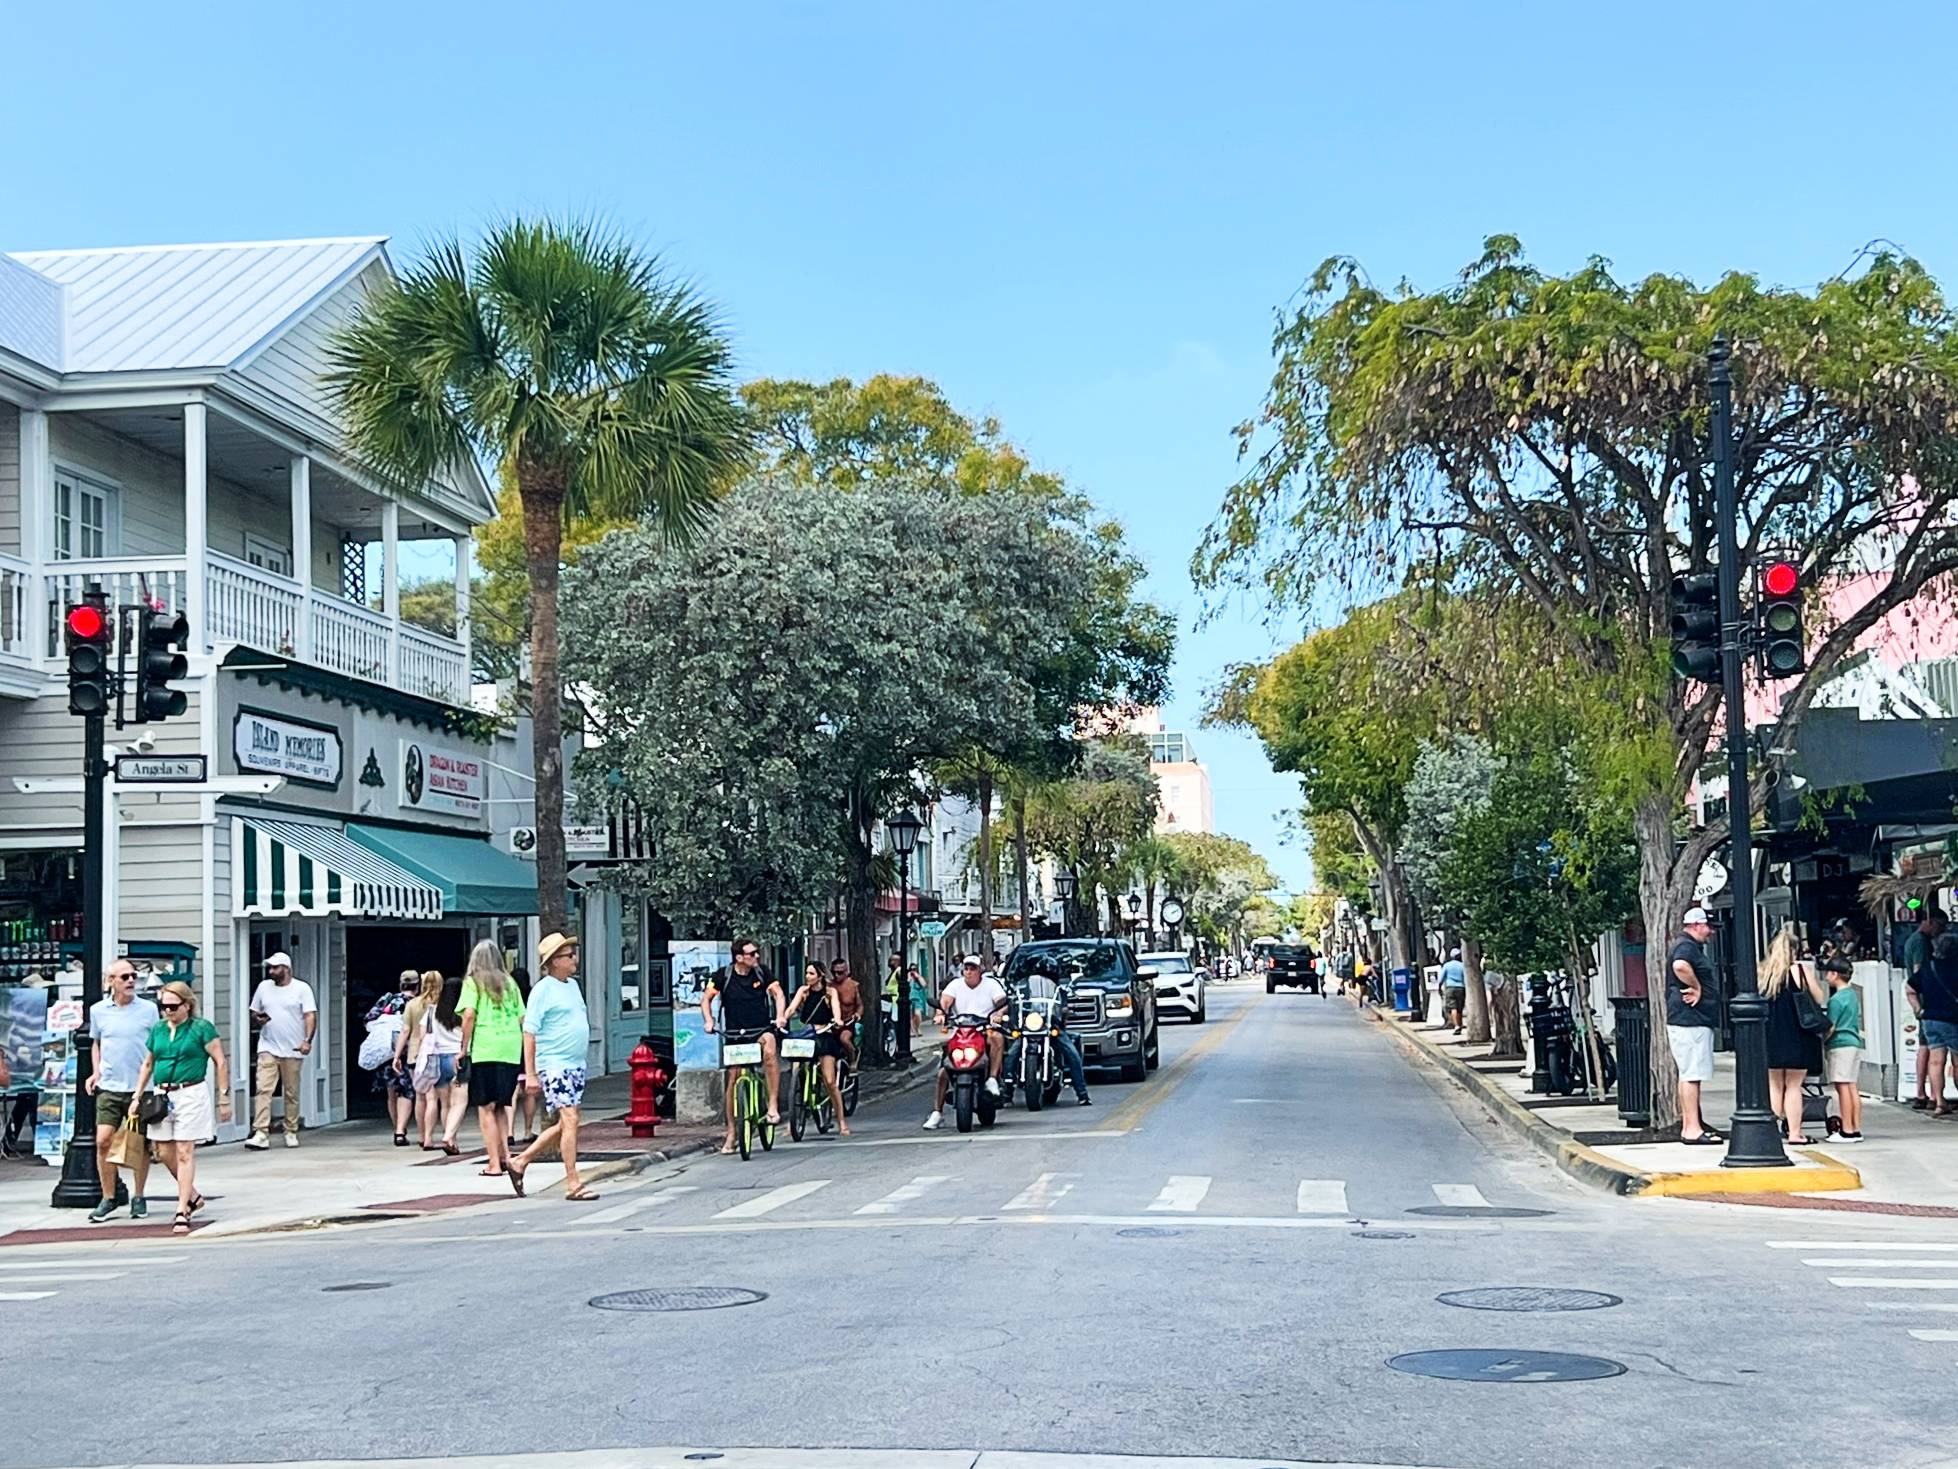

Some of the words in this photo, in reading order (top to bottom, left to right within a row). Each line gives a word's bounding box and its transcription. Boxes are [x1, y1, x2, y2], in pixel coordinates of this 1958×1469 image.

[252, 721, 279, 752] ISLAND
[285, 736, 325, 762] MEMORIES
[133, 762, 173, 775] Angela
[177, 763, 189, 774] St
[1823, 863, 1843, 878] DJ
